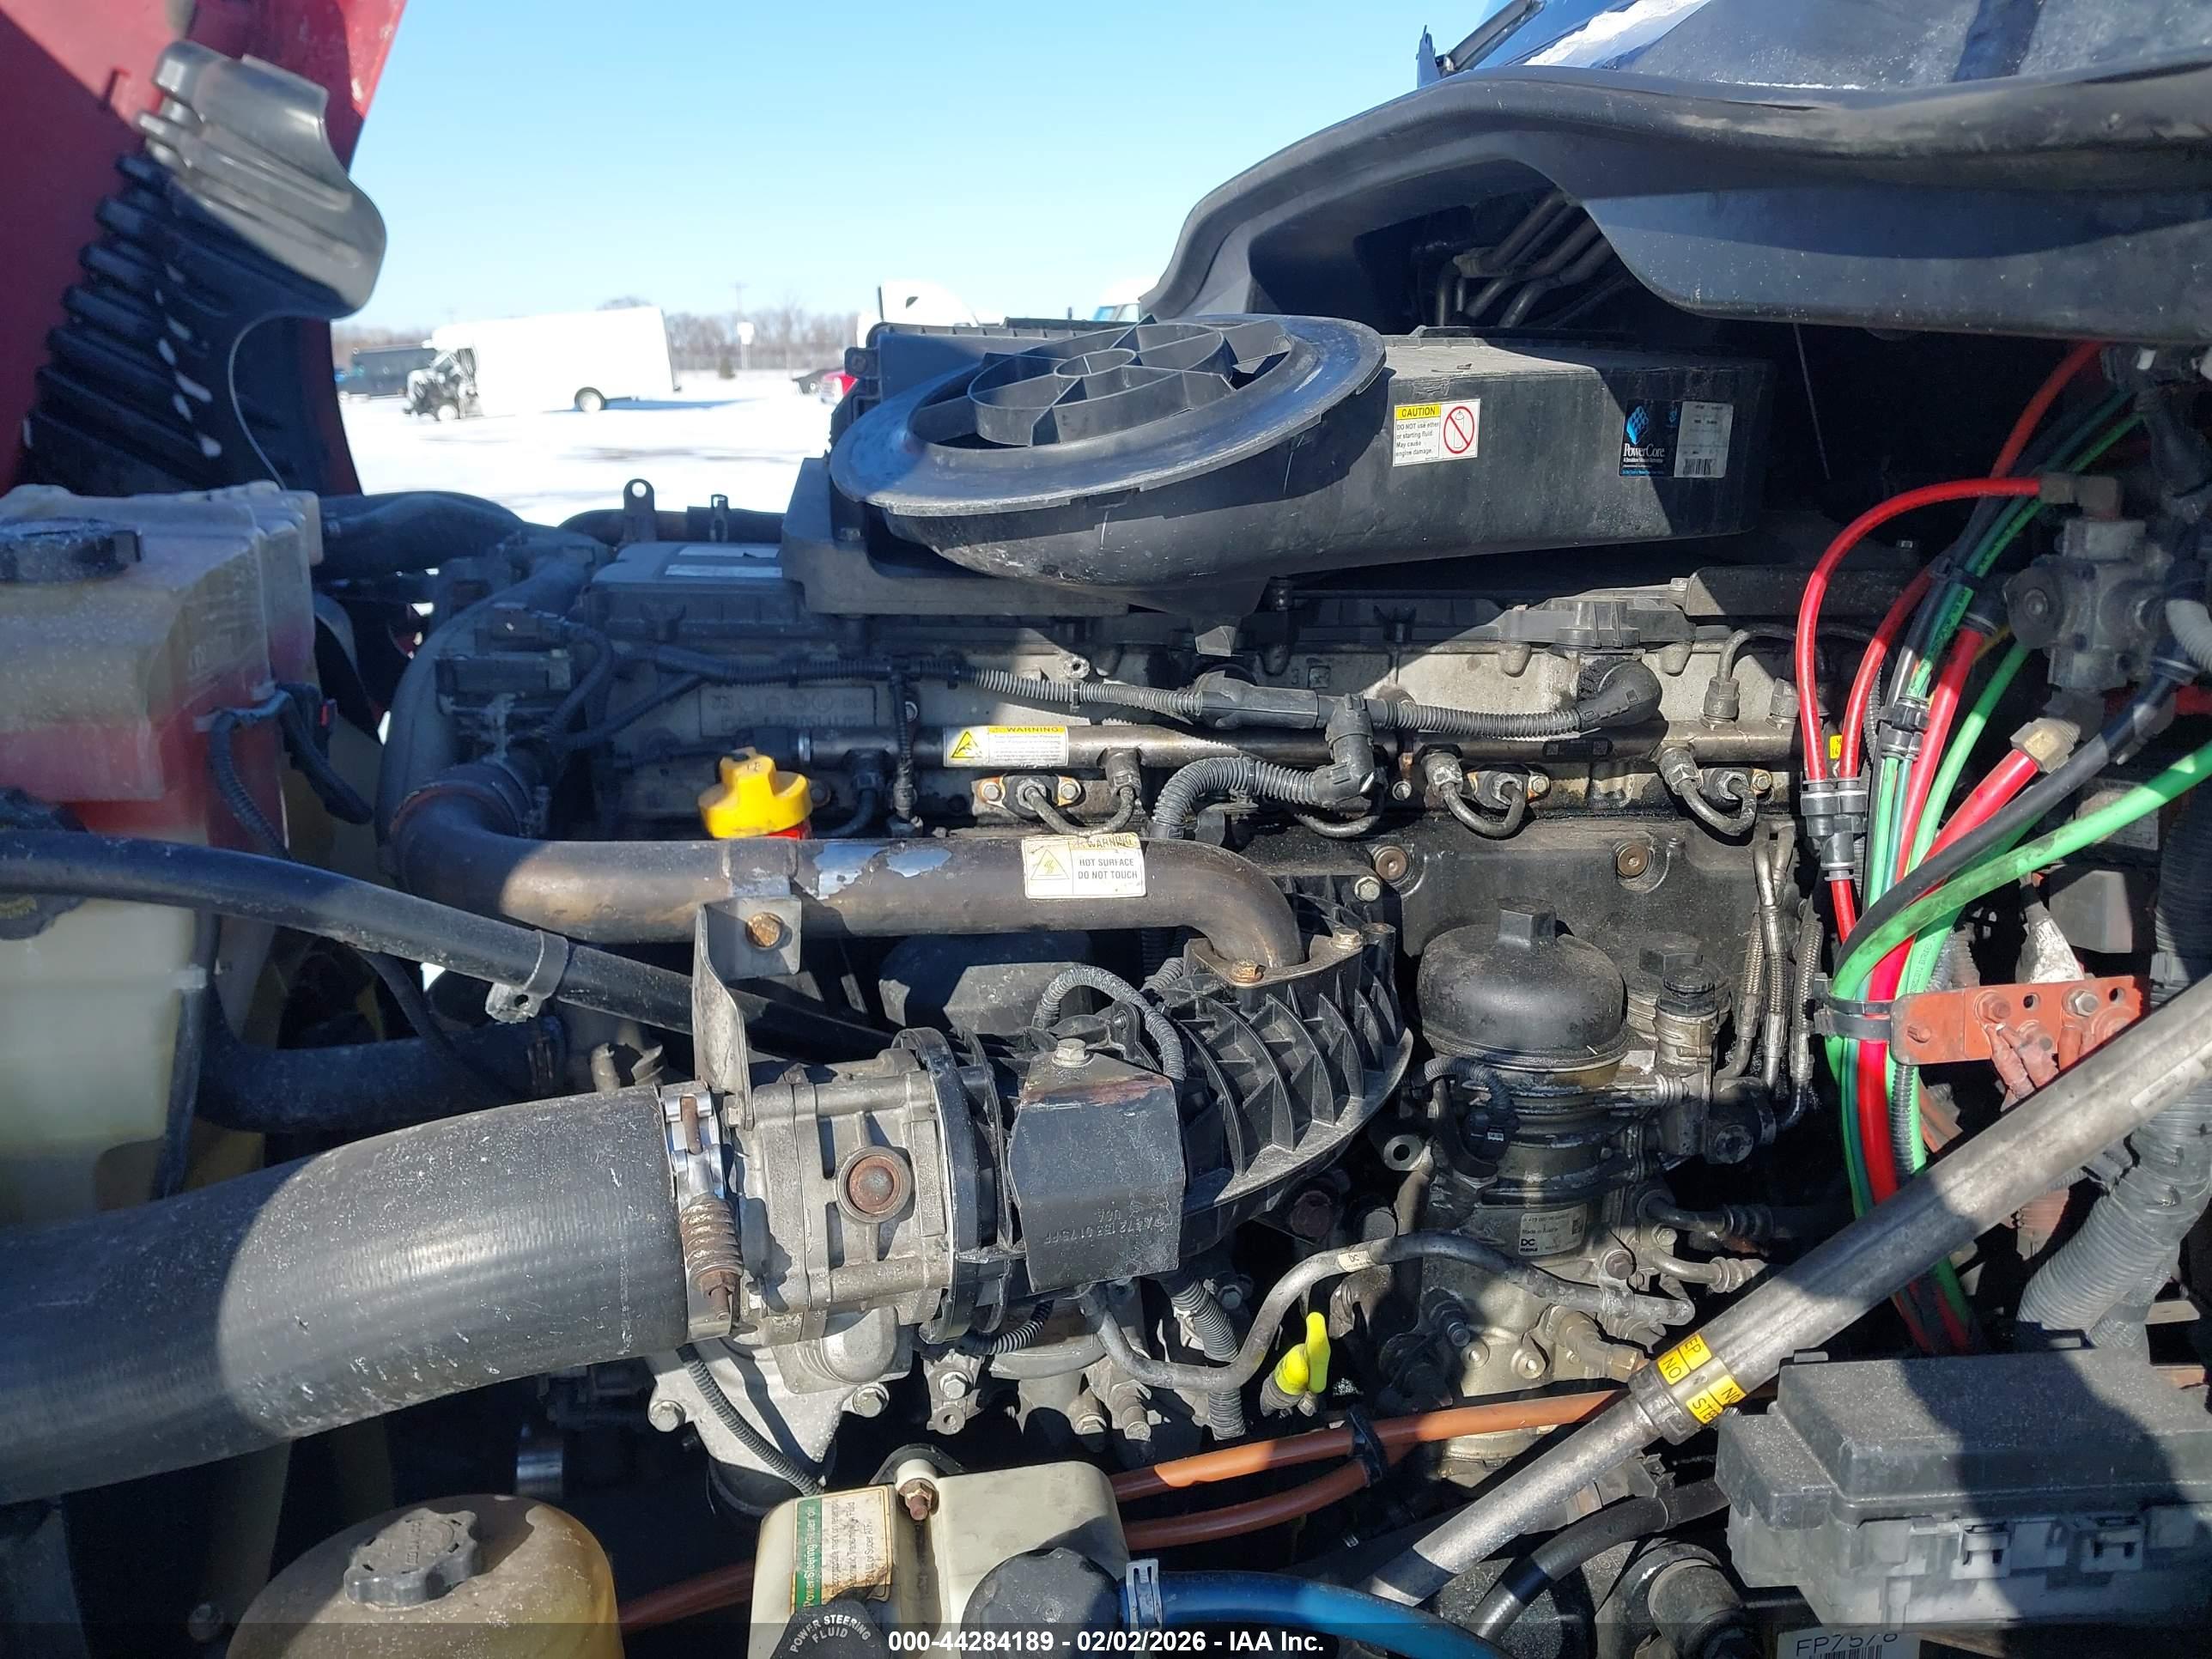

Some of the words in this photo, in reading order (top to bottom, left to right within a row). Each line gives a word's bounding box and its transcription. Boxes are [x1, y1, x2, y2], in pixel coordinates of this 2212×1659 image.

[1401, 406, 1436, 417] CAUTION
[1623, 442, 1666, 458] PowerCore
[1087, 835, 1133, 848] WARNING
[1079, 858, 1096, 866] HOT
[1098, 858, 1134, 866] SURFACE
[1078, 871, 1090, 879] DO
[1091, 871, 1108, 879] NOT
[1111, 871, 1138, 879] TOUCH
[1684, 1337, 1702, 1354] EP
[1662, 1357, 1682, 1380] NO
[1692, 1397, 1717, 1420] STE
[805, 1506, 816, 1544] Reseroir
[804, 1544, 817, 1580] Steering
[803, 1581, 815, 1607] Power
[789, 1620, 822, 1653] POWER
[823, 1614, 872, 1641] STEERING
[811, 1626, 848, 1644] FLUID
